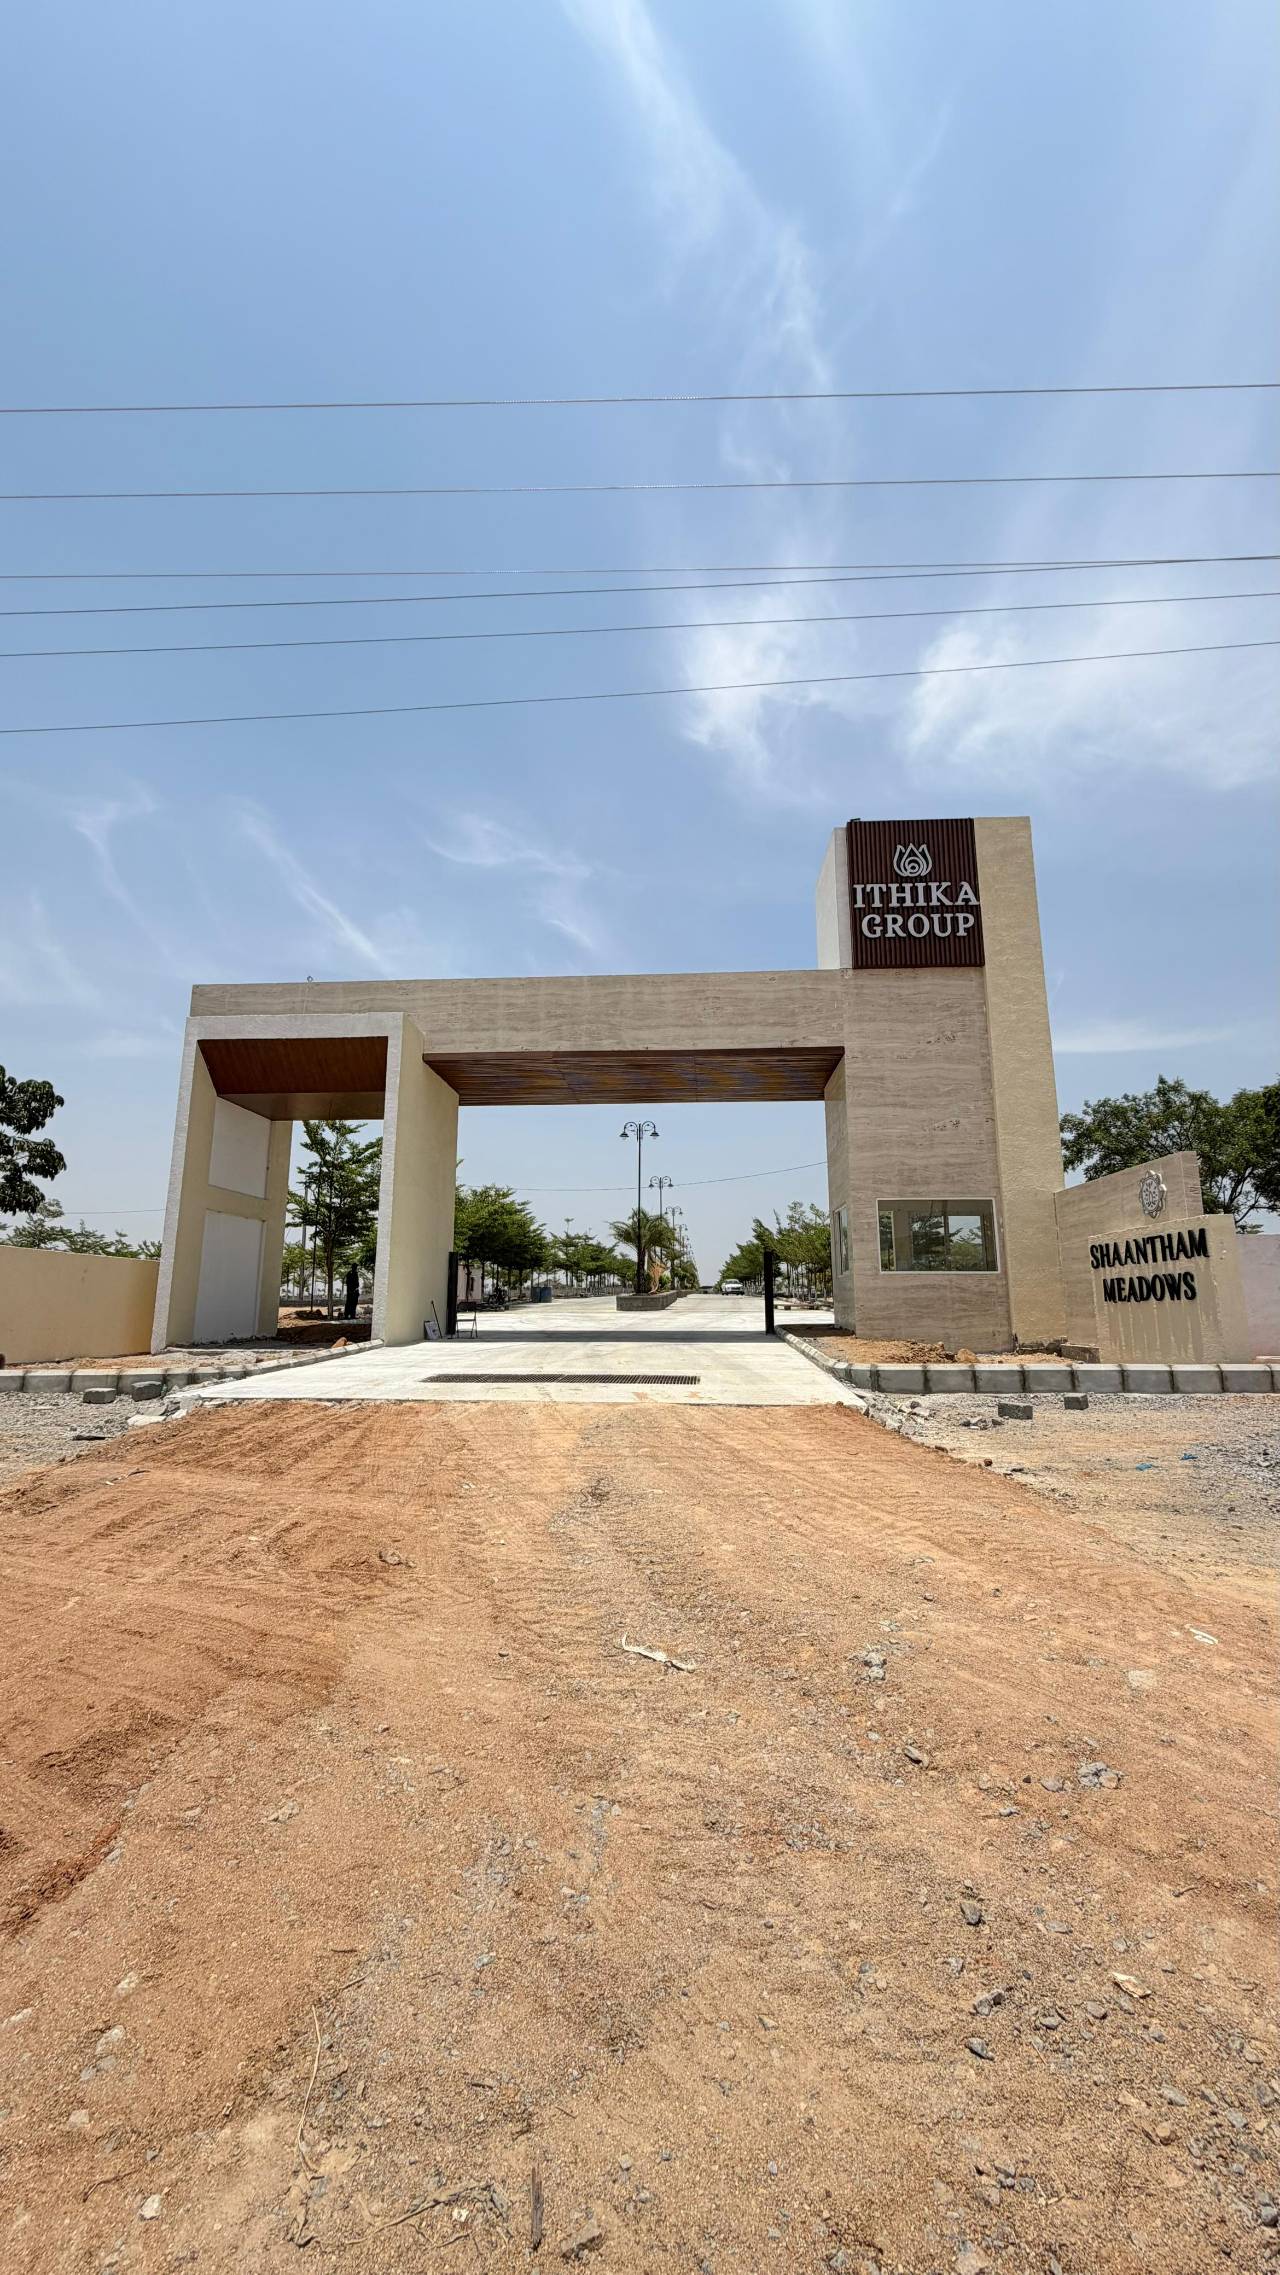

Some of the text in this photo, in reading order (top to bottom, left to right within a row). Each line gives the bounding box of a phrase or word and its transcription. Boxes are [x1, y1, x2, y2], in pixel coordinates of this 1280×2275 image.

[853, 881, 980, 908] ITHIKA
[861, 913, 975, 938] GROUP
[1090, 1228, 1210, 1269] SHAANTHAM
[1102, 1272, 1197, 1303] MEADOWS
